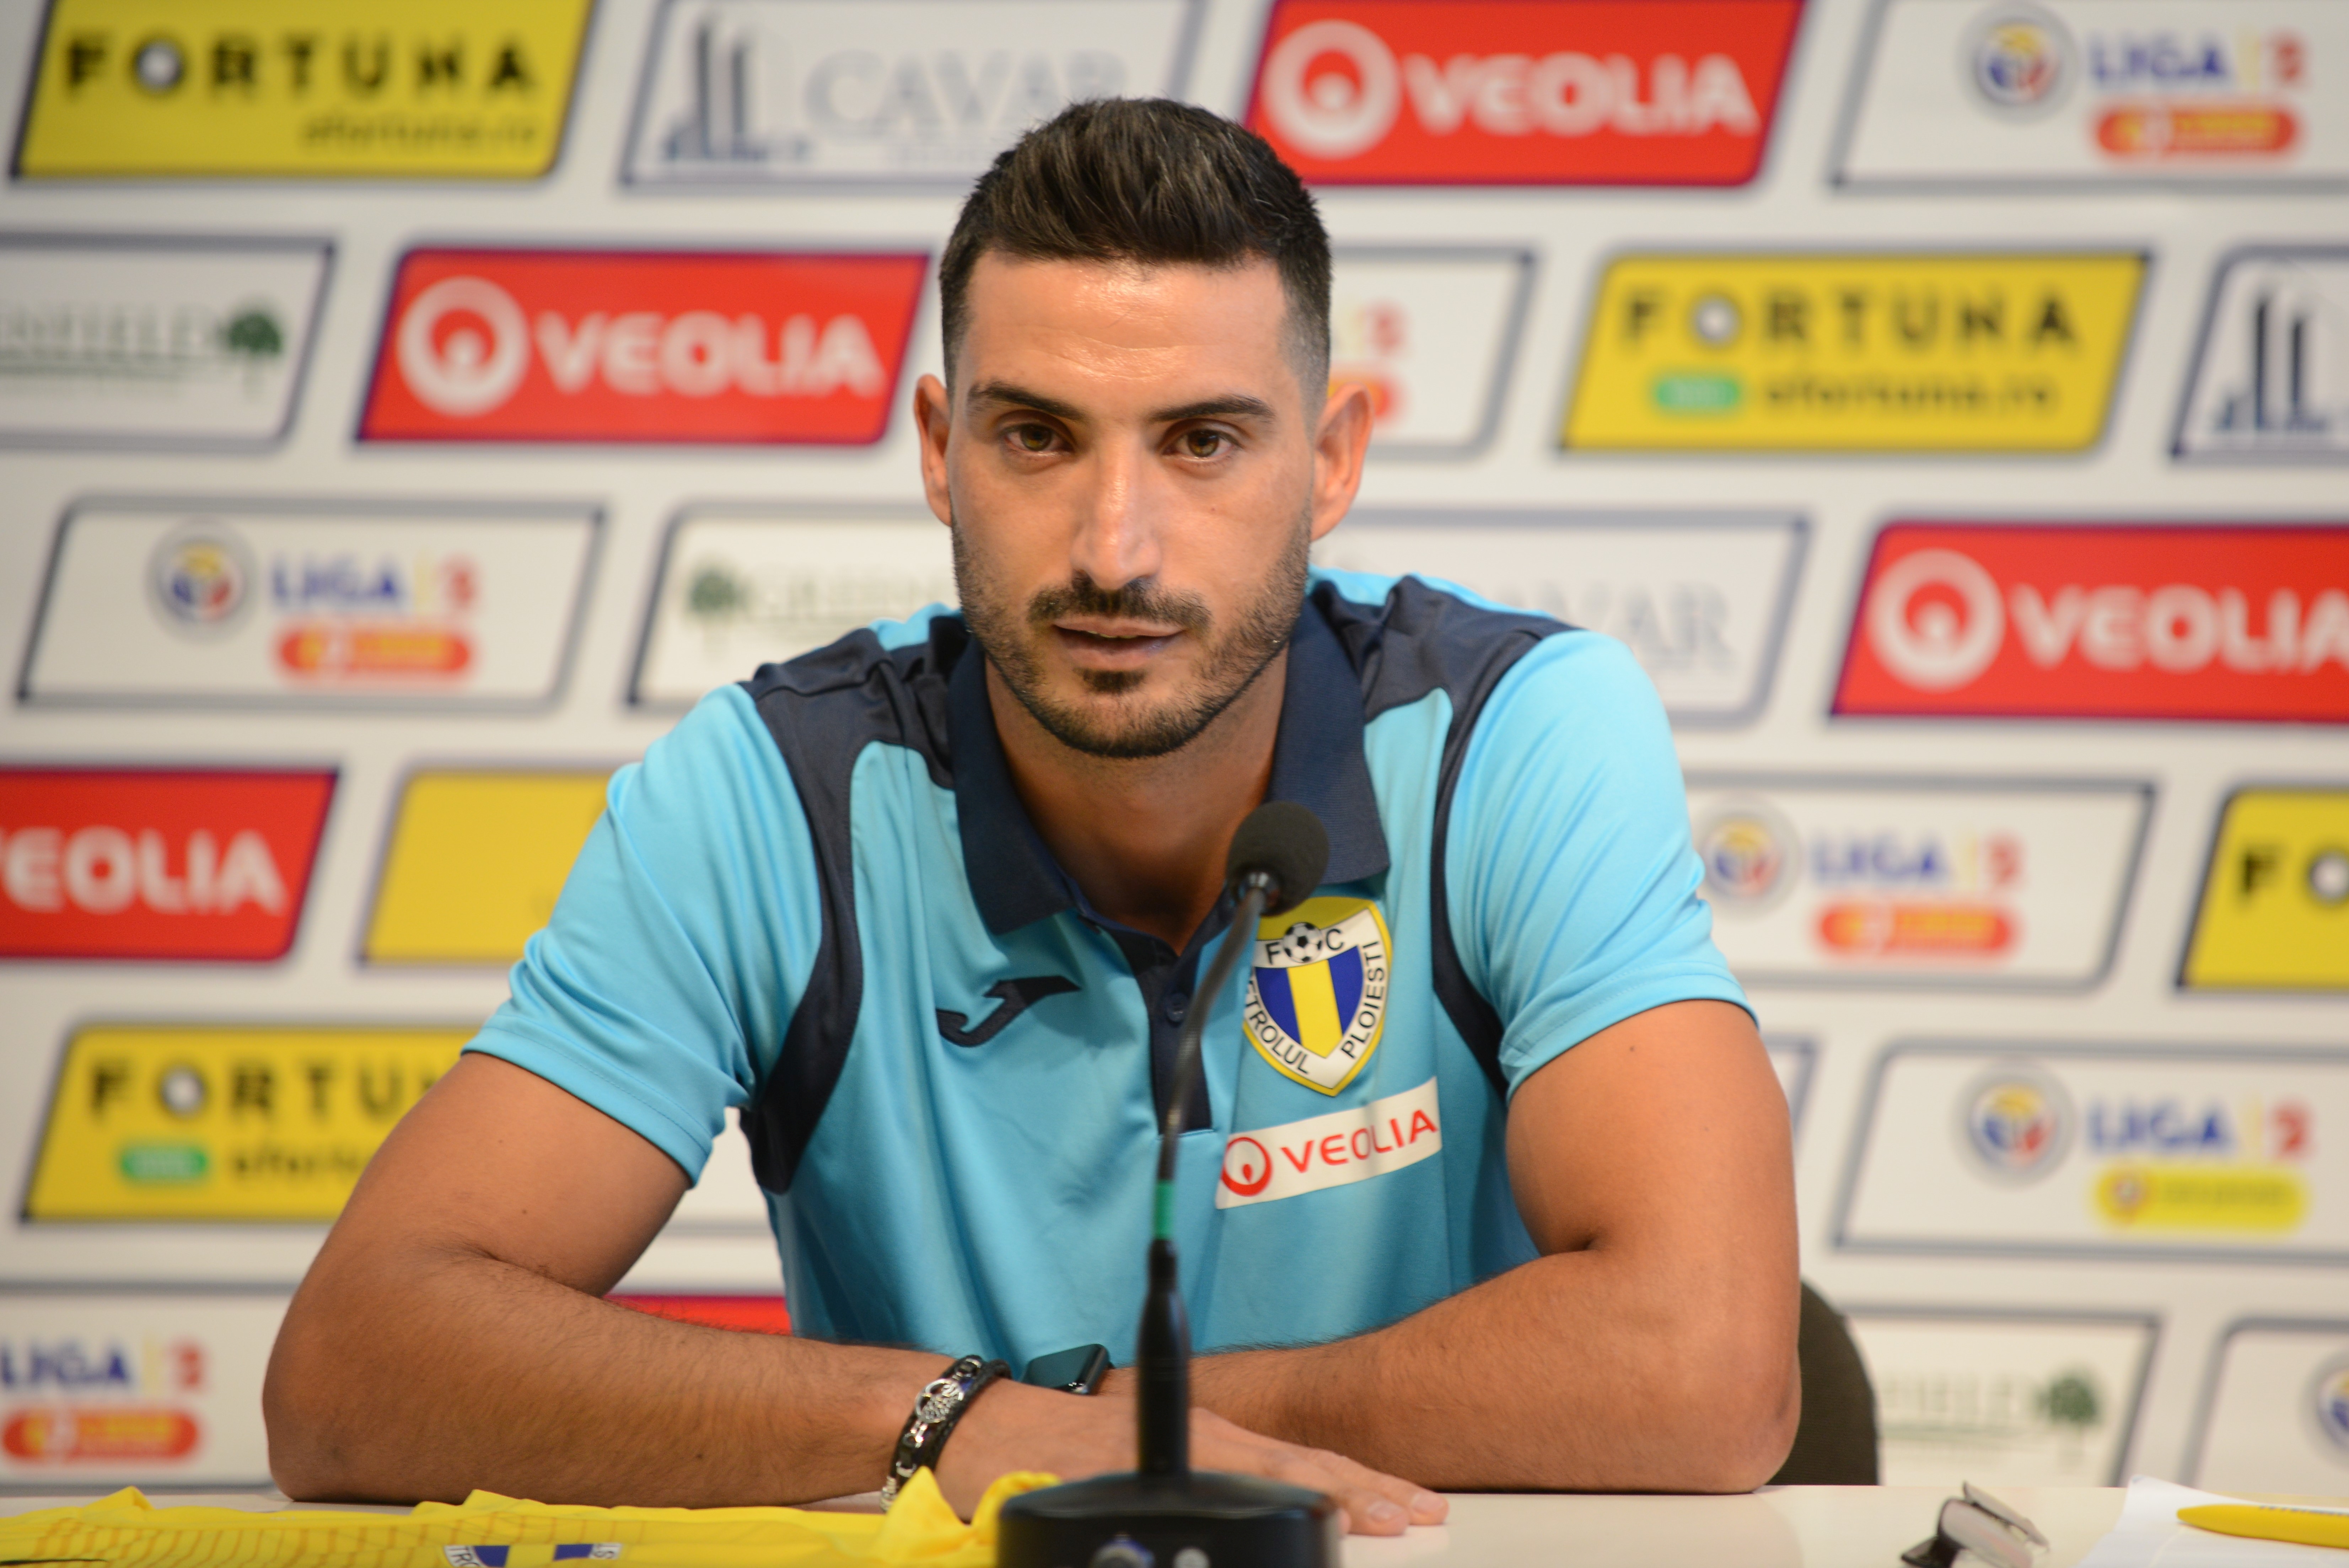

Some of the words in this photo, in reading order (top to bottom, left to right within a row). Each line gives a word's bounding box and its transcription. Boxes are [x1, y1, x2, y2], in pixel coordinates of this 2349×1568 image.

[1399, 51, 1761, 138] VEOLIA
[533, 309, 886, 399] VEOLIA
[0, 825, 291, 915] EOLIA
[1280, 1109, 1439, 1174] VEOLIA
